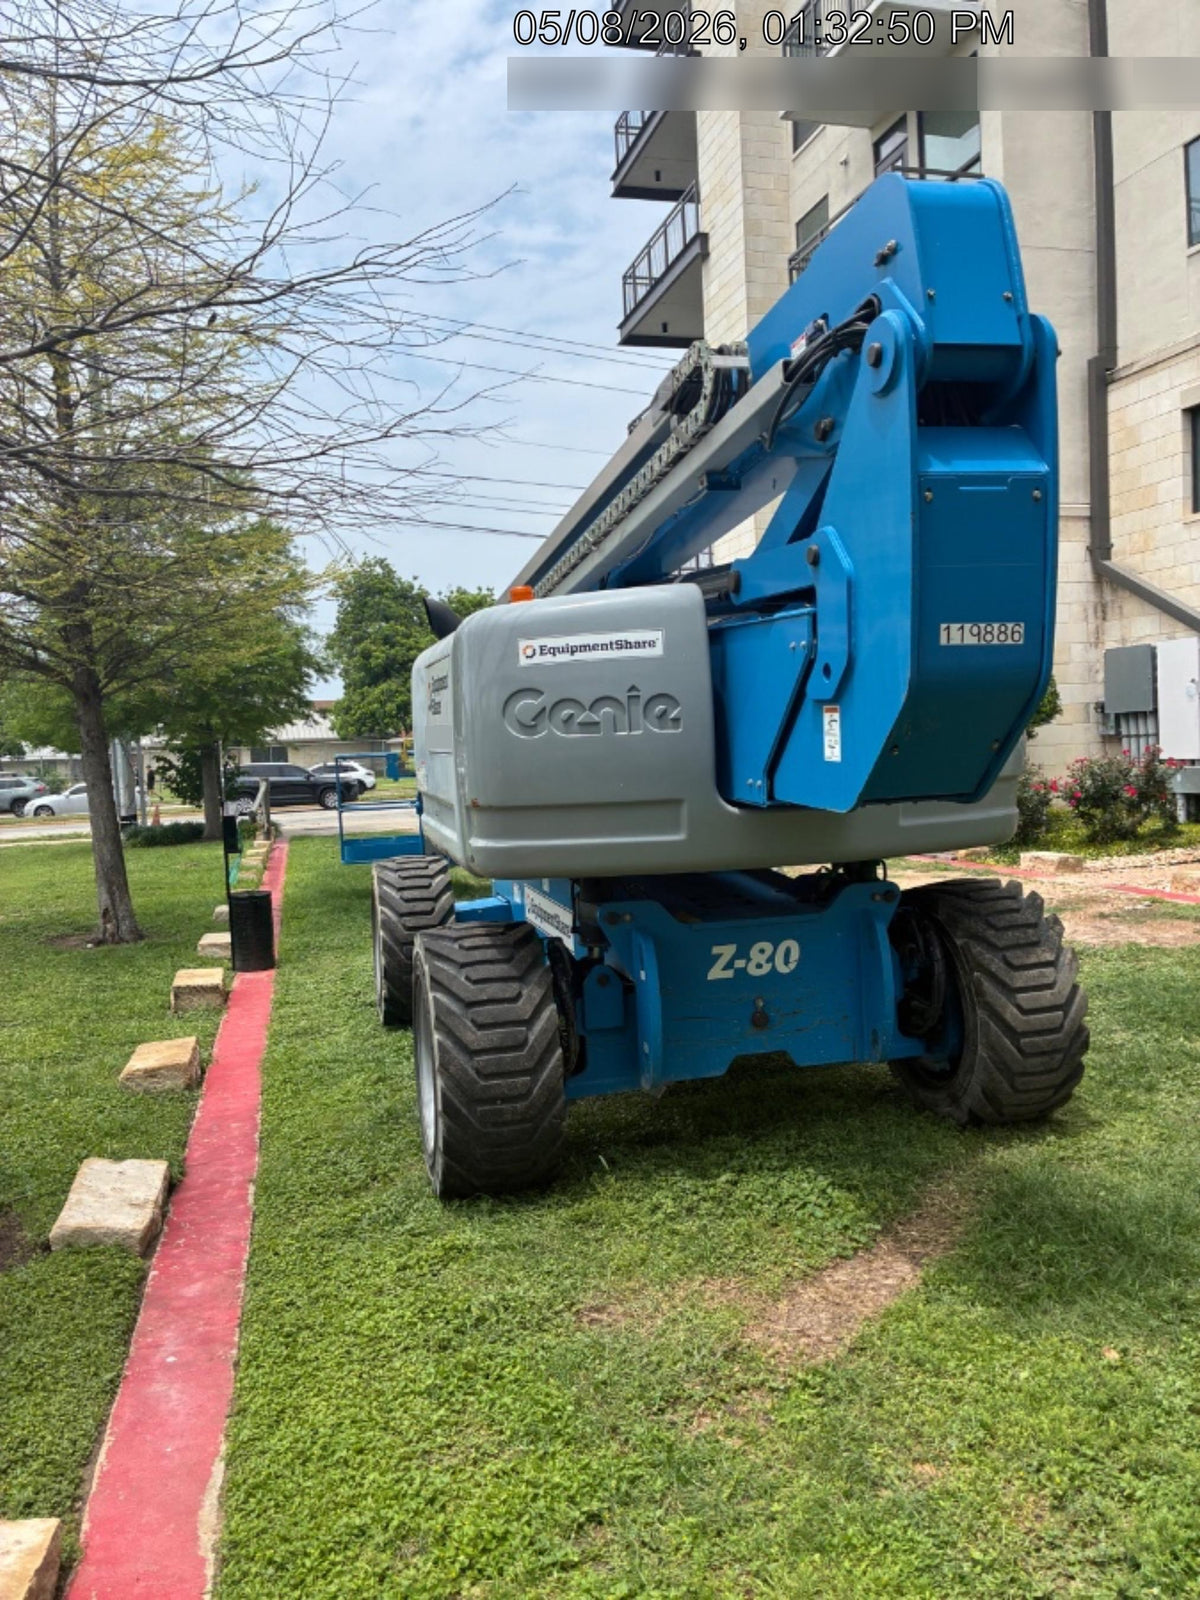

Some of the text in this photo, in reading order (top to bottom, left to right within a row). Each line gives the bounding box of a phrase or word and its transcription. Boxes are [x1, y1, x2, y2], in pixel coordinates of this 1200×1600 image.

[538, 638, 657, 657] EquipmentShare
[942, 622, 1023, 645] 119886
[502, 684, 684, 739] Genie
[706, 939, 801, 981] Z-80
